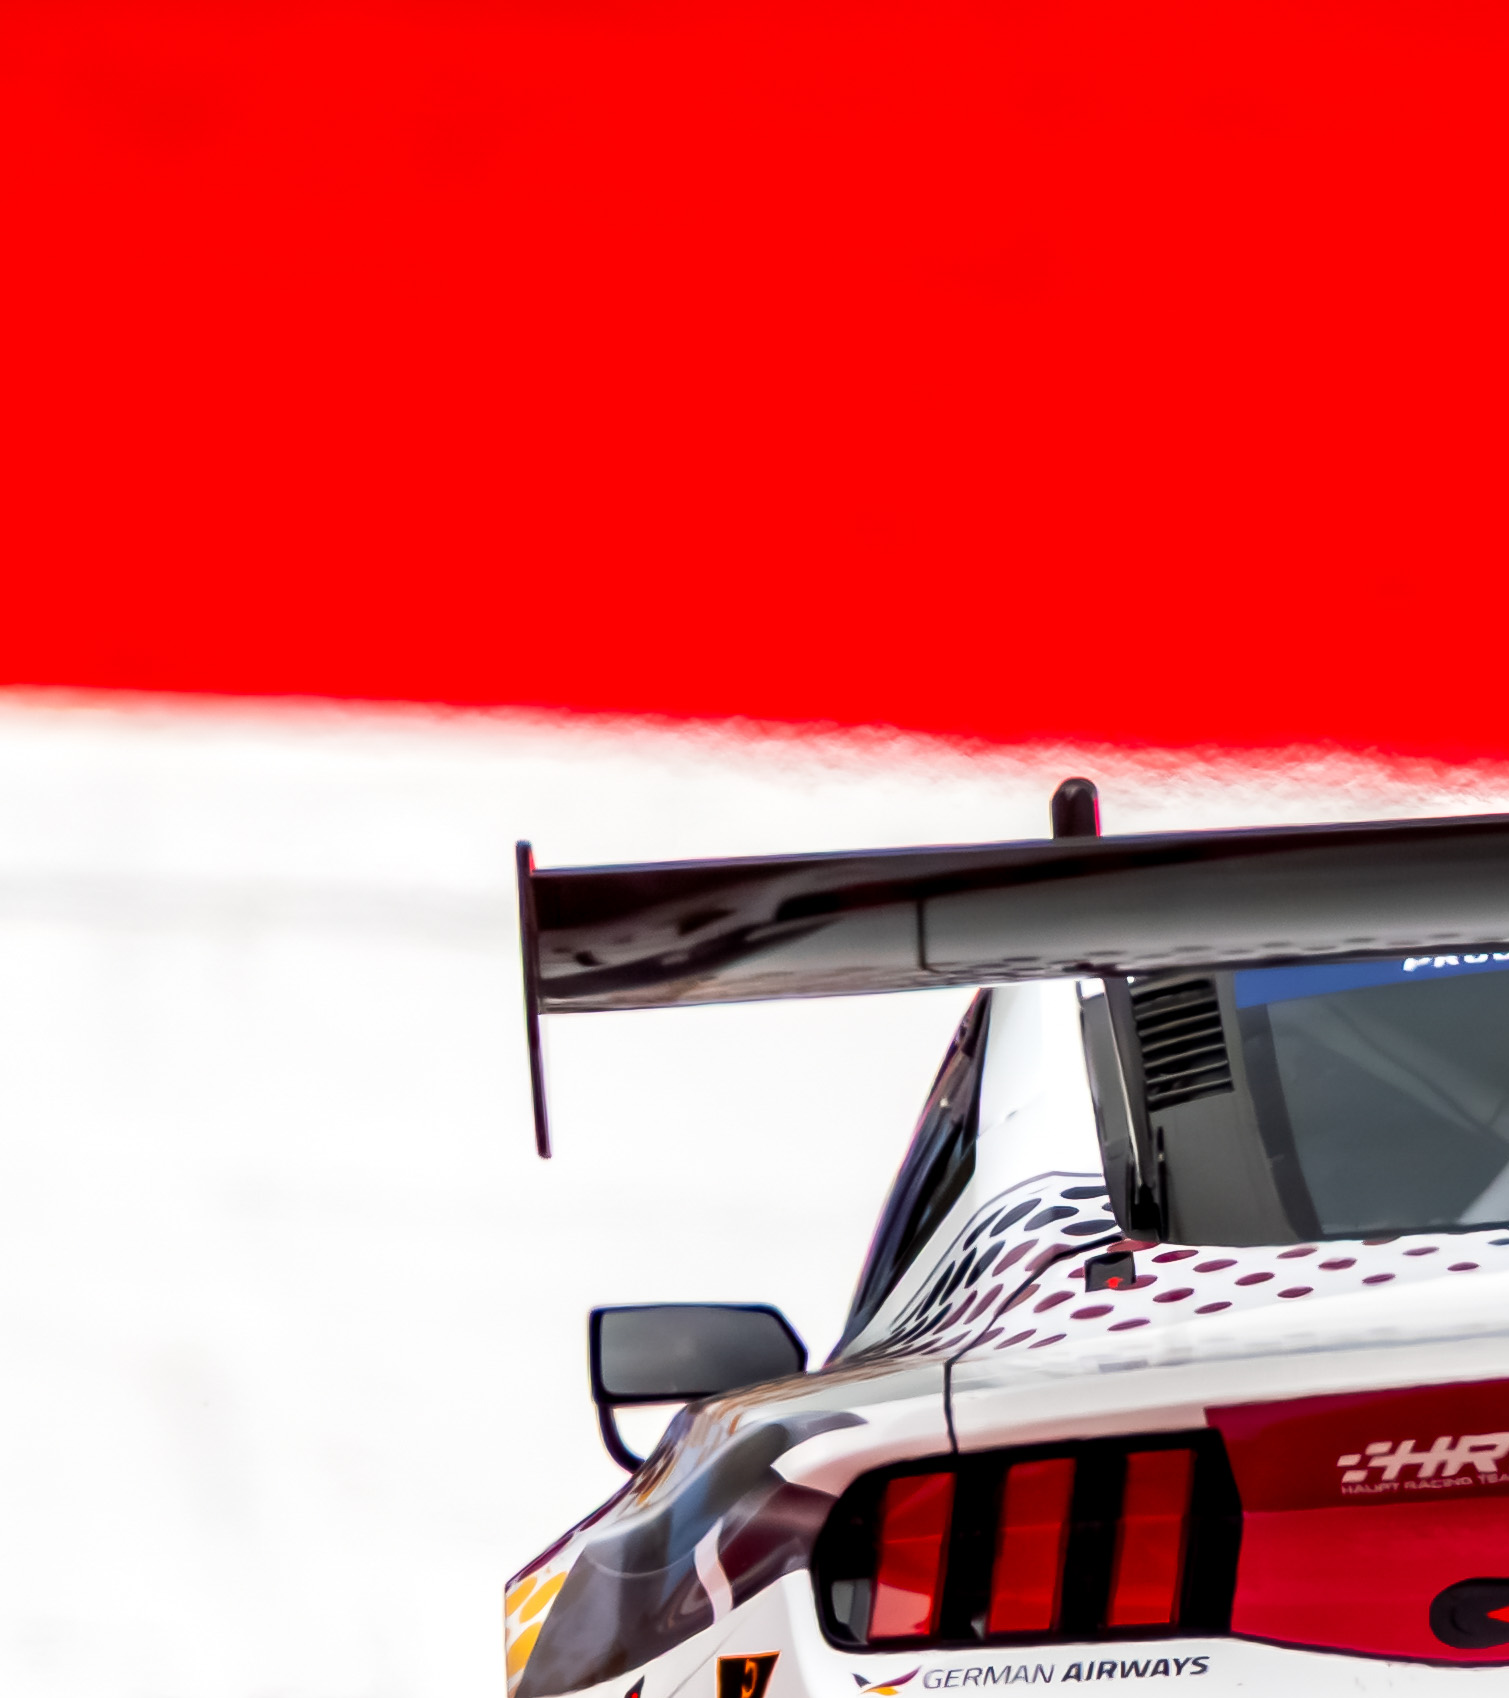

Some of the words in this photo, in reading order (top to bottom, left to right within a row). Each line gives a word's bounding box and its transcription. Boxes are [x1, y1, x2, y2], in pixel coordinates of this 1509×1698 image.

[1341, 1482, 1400, 1494] HAUPT
[1404, 1476, 1474, 1490] RACING
[922, 1662, 1055, 1690] GERMAN
[1060, 1655, 1211, 1685] AIRWAYS
